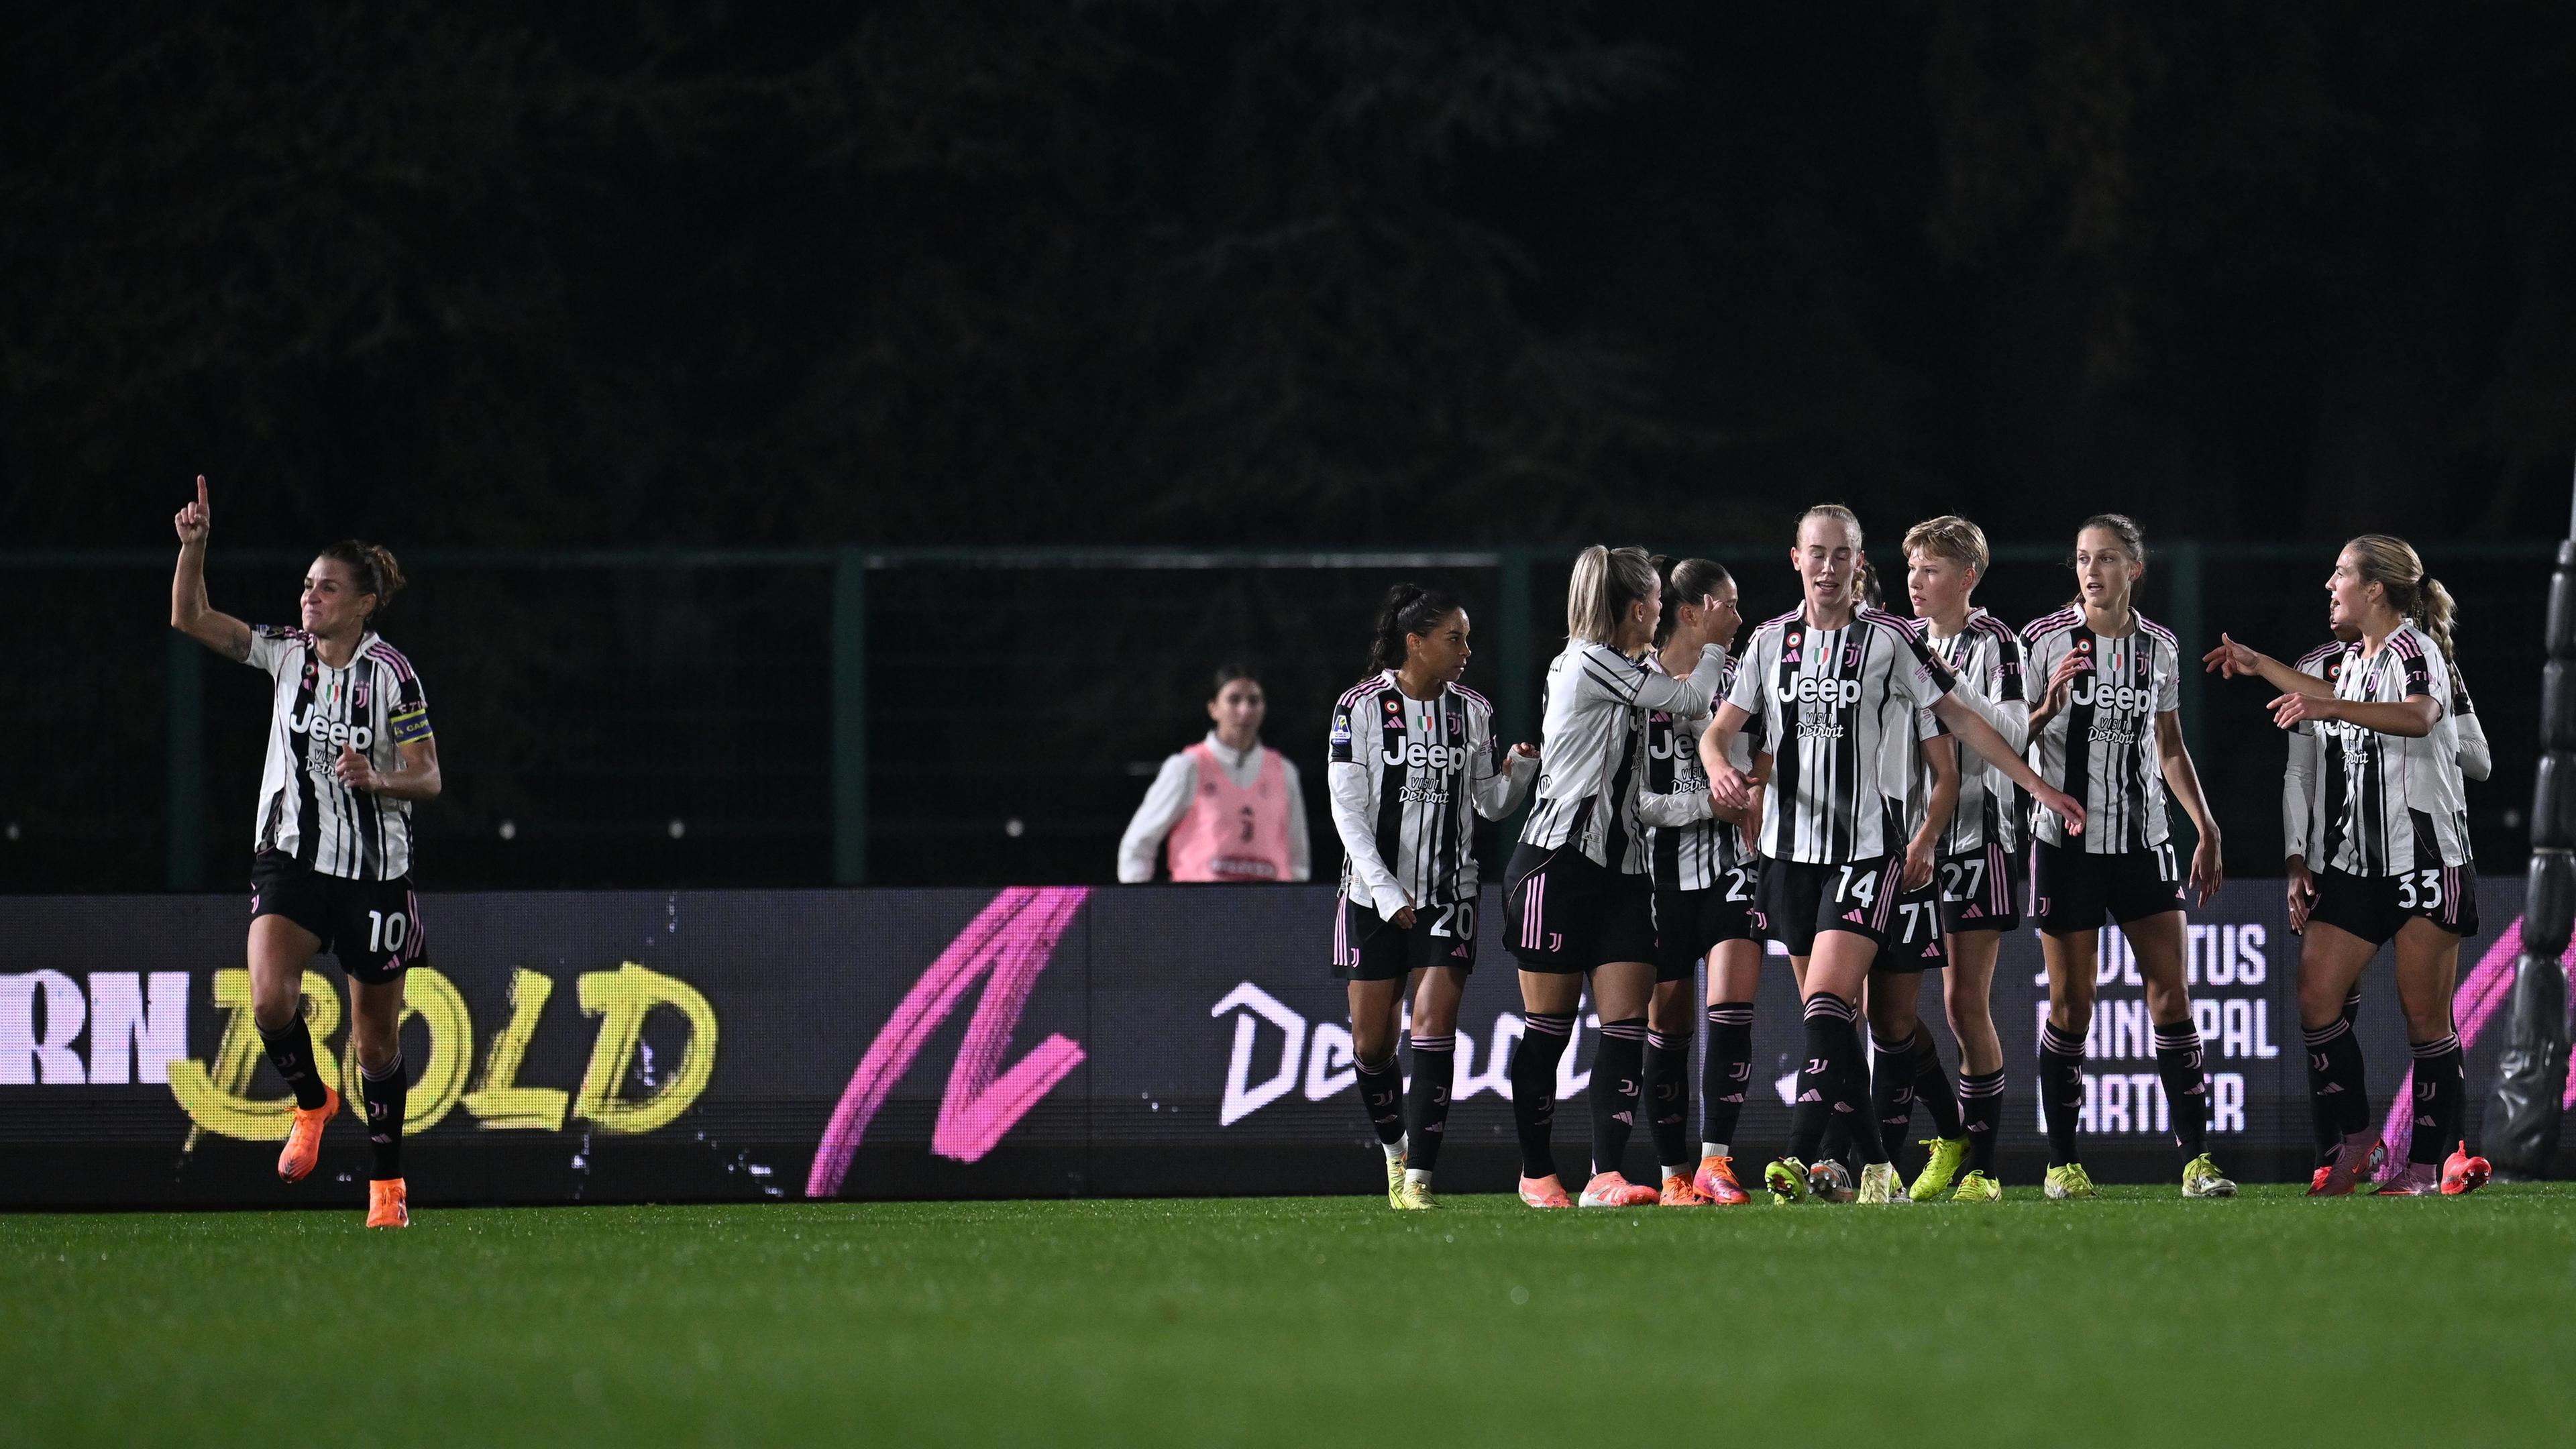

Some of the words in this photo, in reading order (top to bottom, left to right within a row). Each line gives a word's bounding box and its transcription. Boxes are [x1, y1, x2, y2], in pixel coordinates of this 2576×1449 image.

[1778, 670, 1862, 709] Jeep
[2072, 676, 2151, 718] Jeep
[290, 702, 373, 754] Jeep
[1795, 720, 1844, 739] Detroit
[1805, 712, 1833, 724] VISIT
[2088, 724, 2135, 745] Detroit
[2100, 717, 2129, 731] VISIT
[314, 749, 337, 763] VISI
[1383, 735, 1466, 775] Jeep
[1650, 729, 1695, 759] Je
[305, 755, 337, 776] Detr
[1411, 777, 1440, 790] VISIT
[1681, 767, 1708, 780] VISI
[1399, 786, 1450, 804] Detroit
[1835, 865, 1878, 908] 14
[1941, 859, 1985, 902] 27
[2398, 869, 2442, 909] 33
[368, 910, 407, 953] 10
[1430, 902, 1474, 941] 20
[1899, 900, 1939, 944] 71
[168, 961, 718, 1142] BOLD
